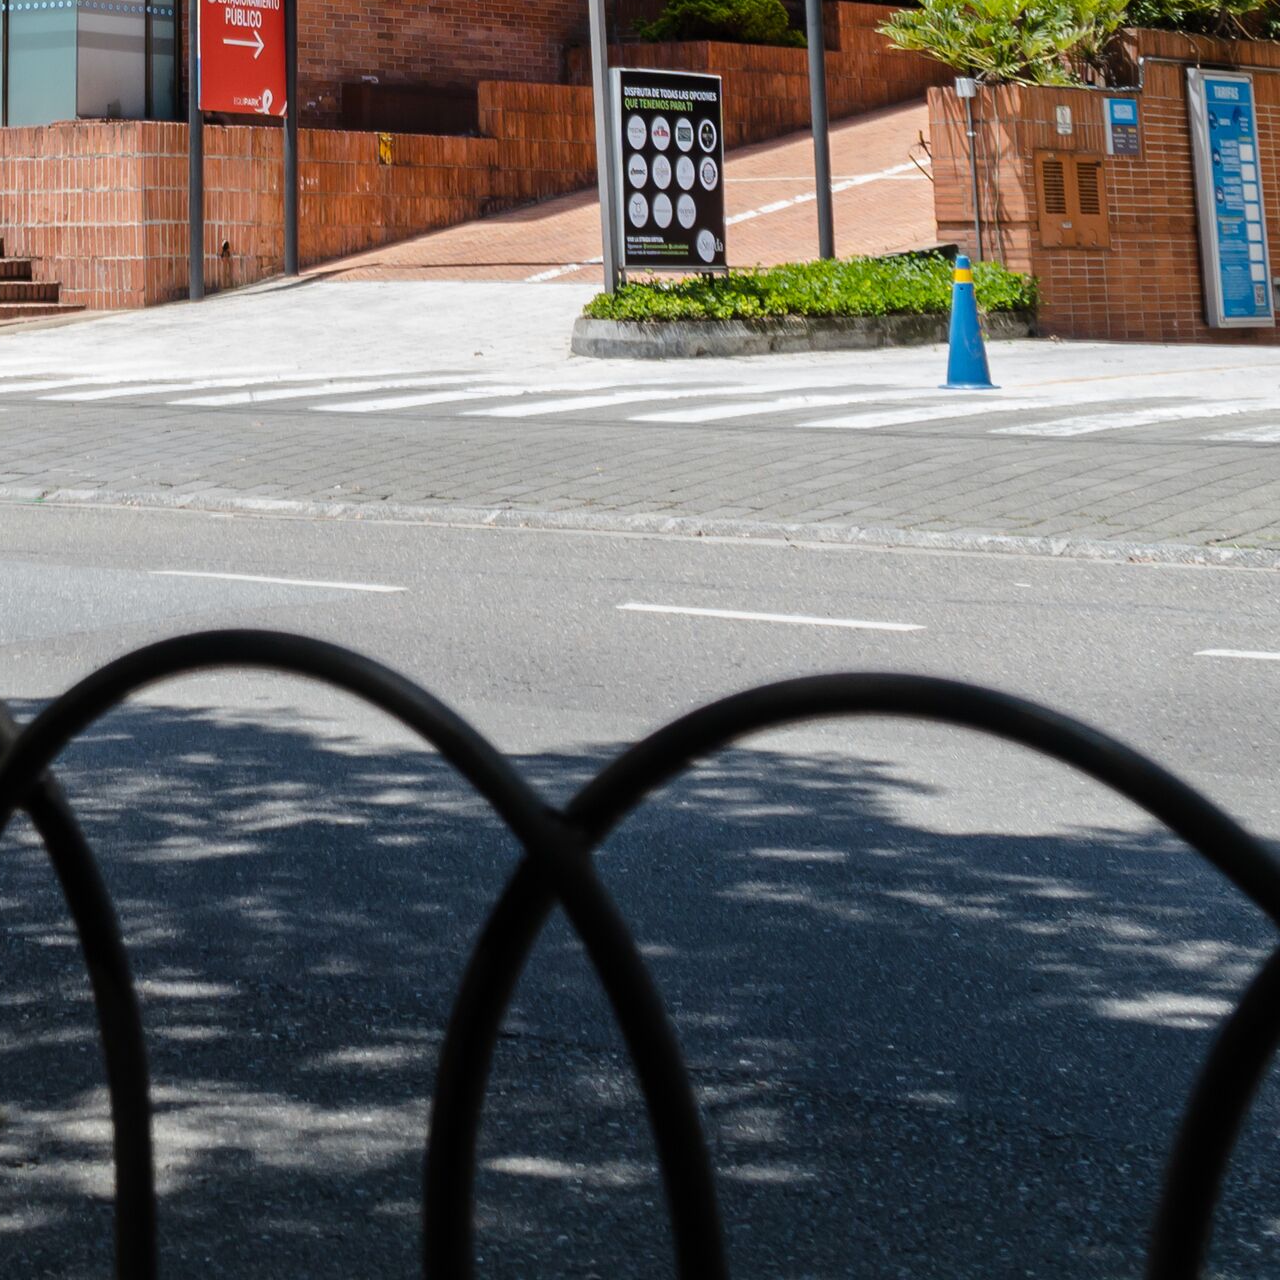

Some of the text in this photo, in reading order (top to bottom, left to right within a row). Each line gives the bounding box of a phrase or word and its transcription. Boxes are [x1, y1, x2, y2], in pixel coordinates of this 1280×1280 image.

[225, 4, 262, 29] PÚBLICO
[623, 86, 717, 102] DISFRUTA DE TODAS LAS OPCIONES
[624, 98, 694, 112] QUE TENEMOS PARA TI
